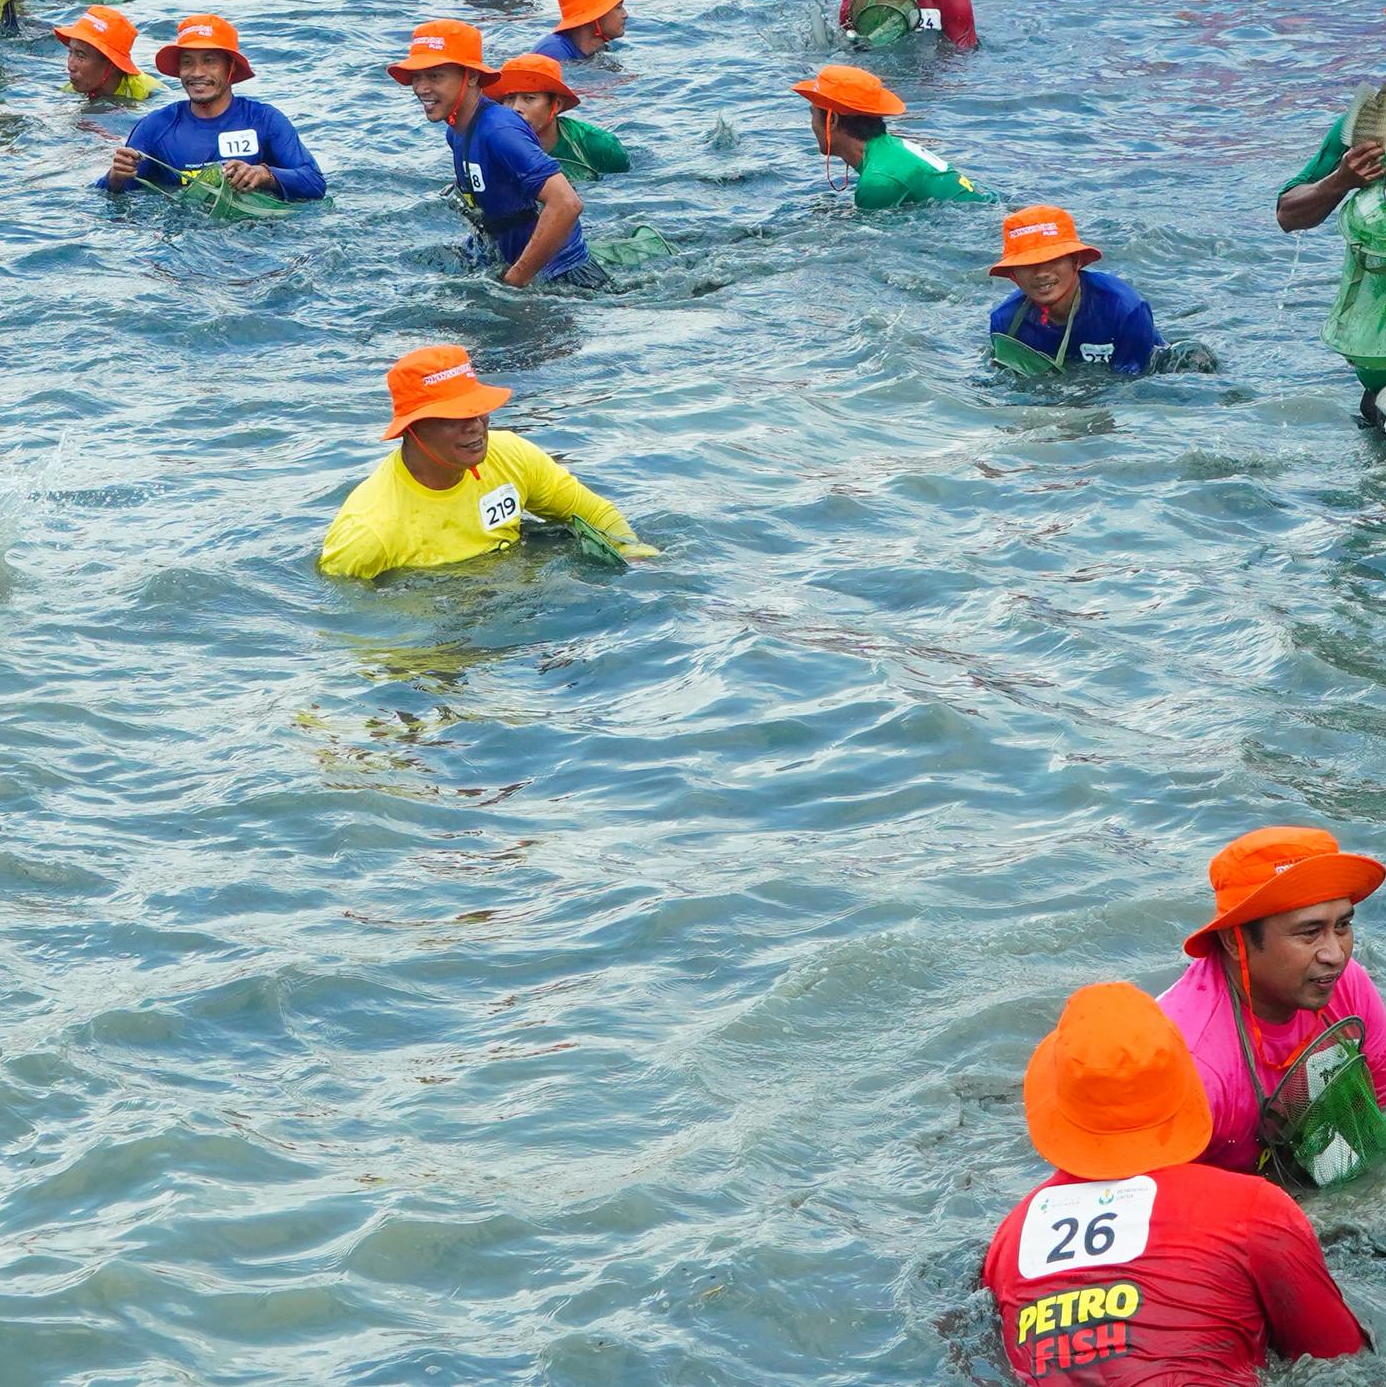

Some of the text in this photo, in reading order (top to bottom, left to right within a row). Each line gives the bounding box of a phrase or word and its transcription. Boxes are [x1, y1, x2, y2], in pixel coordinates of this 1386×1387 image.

[226, 139, 252, 155] 112
[485, 496, 516, 526] 219
[1045, 1211, 1120, 1265] 26
[1017, 1282, 1140, 1346] PETRO
[1035, 1320, 1129, 1376] FISH
